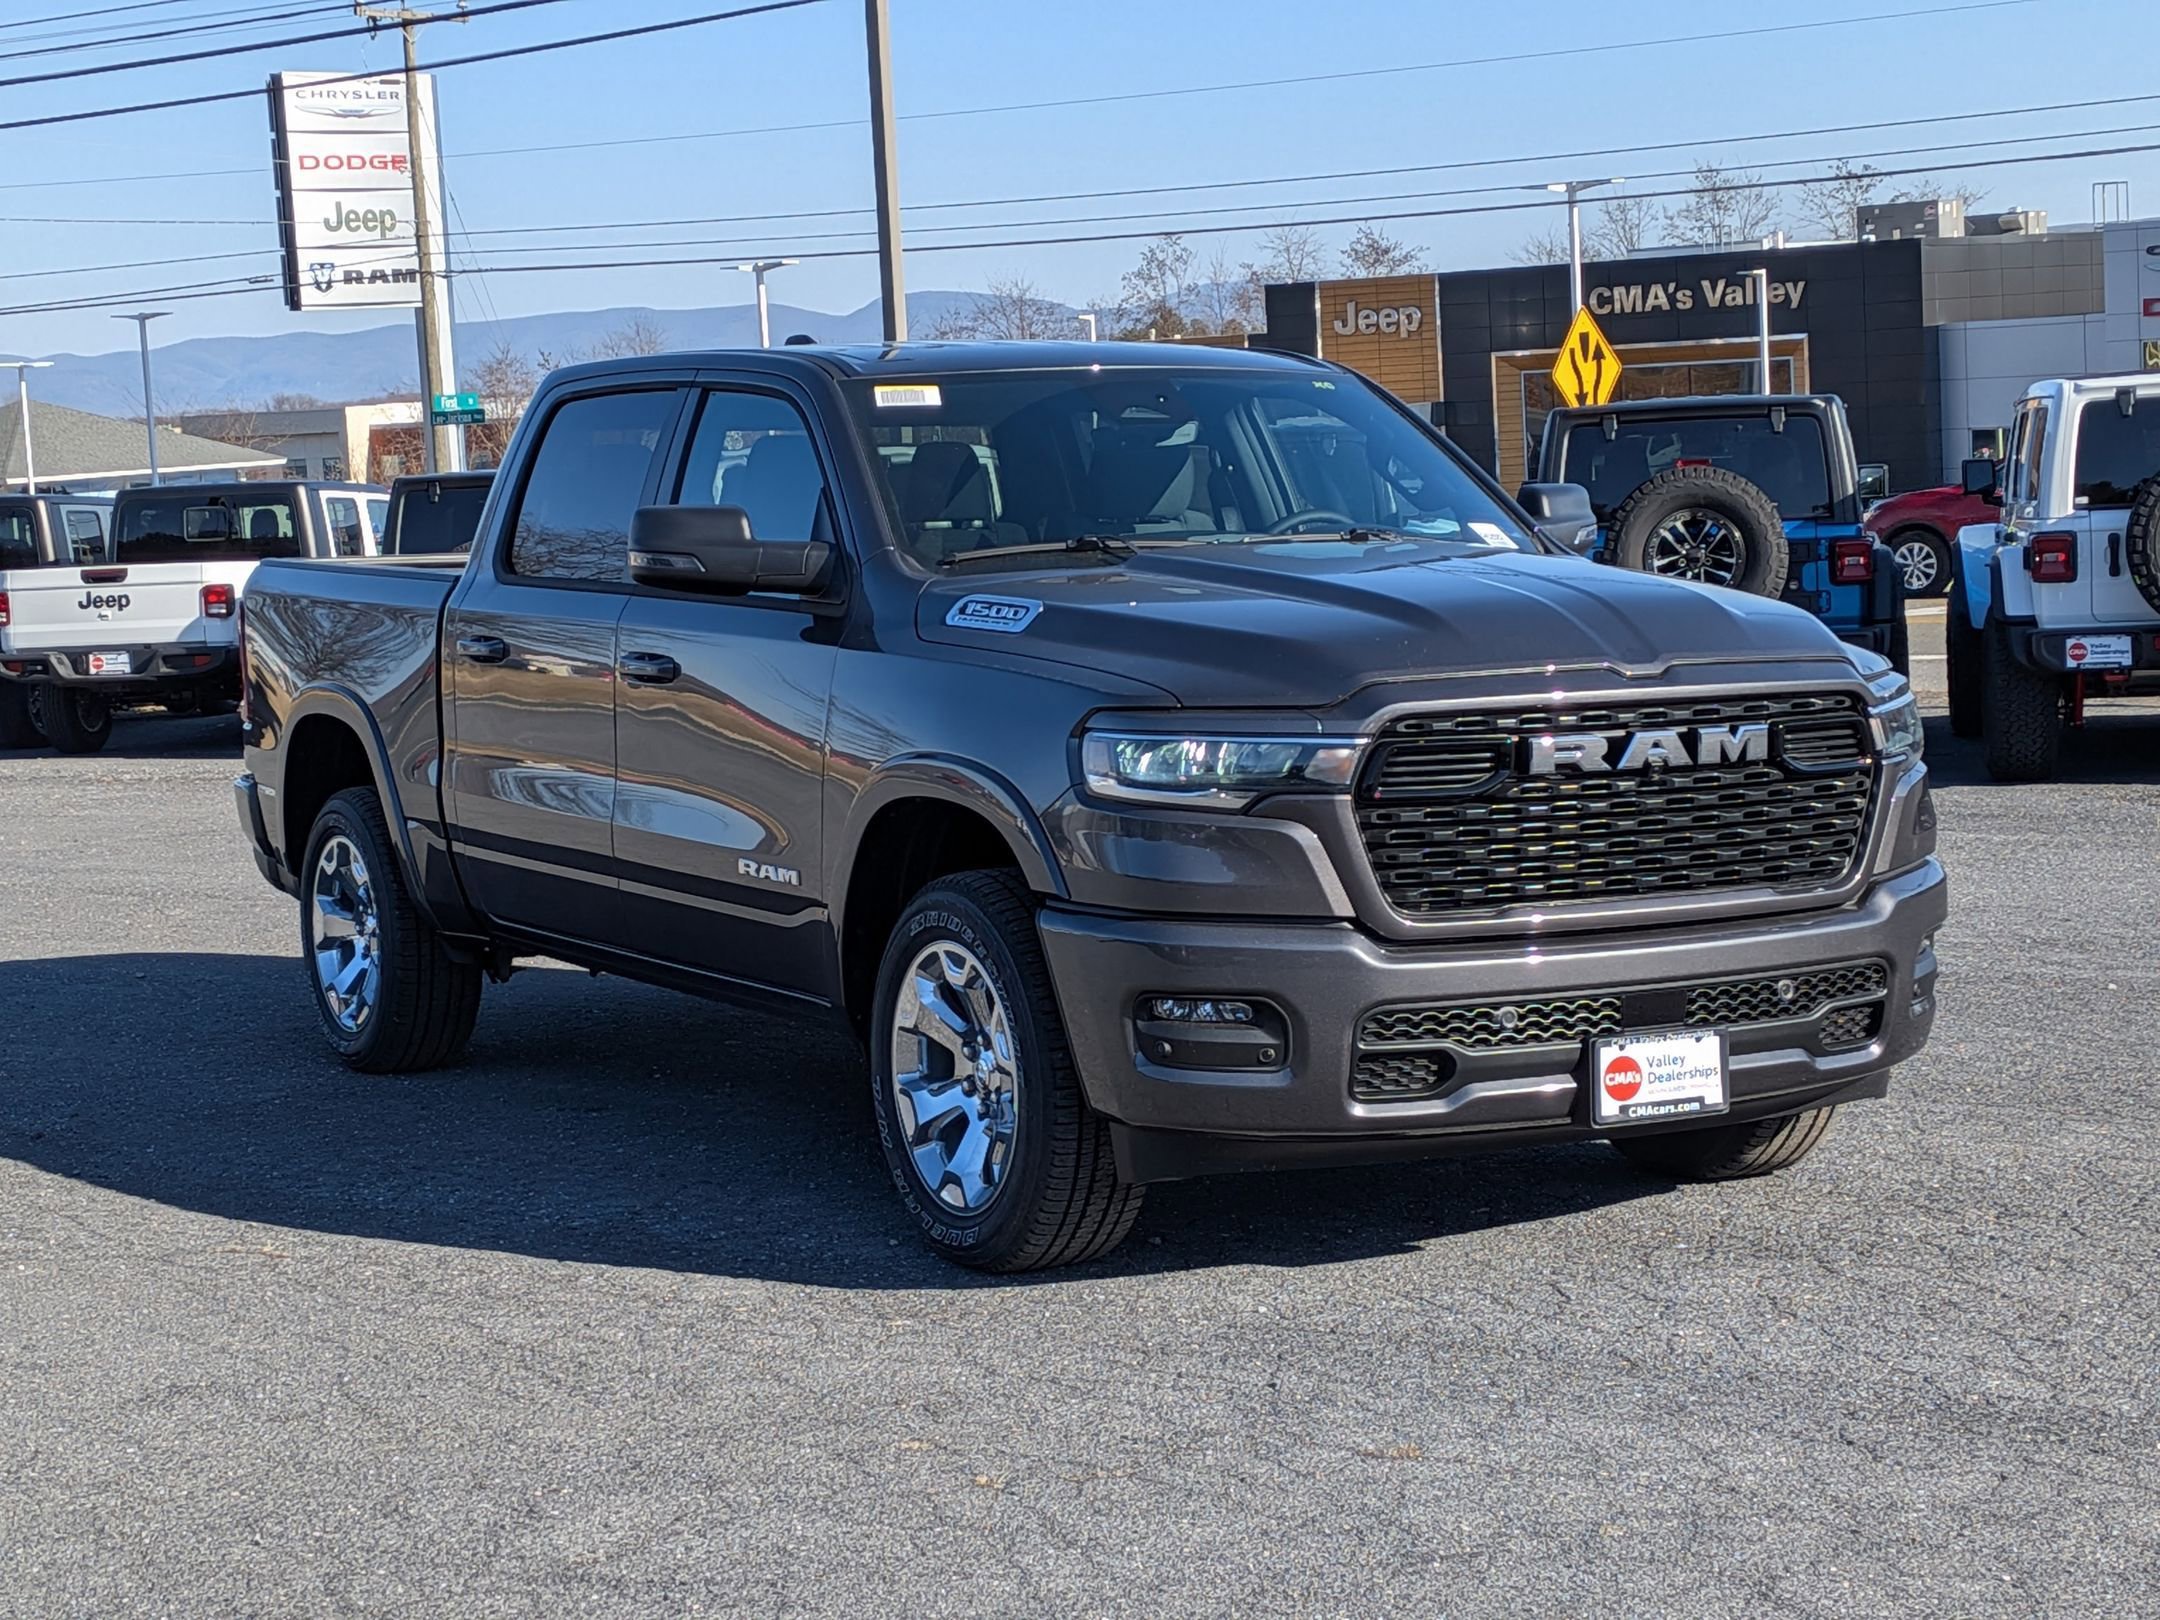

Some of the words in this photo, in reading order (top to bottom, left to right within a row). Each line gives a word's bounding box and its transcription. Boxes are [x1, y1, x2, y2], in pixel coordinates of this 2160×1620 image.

[295, 90, 400, 100] CHRYSLER
[298, 155, 408, 170] DODGE
[323, 201, 397, 240] Jeep
[343, 268, 418, 285] RAM
[1589, 281, 1694, 315] CMA's
[1333, 301, 1422, 338] Jeep
[78, 591, 131, 612] Jeep
[965, 602, 1027, 620] 1500
[1528, 723, 1769, 776] RAM
[737, 857, 800, 886] RAM
[1646, 1054, 1686, 1069] Valley
[1604, 1070, 1641, 1086] CMA's
[1647, 1066, 1719, 1084] Dealerships
[1628, 1101, 1701, 1118] CMAcars.com
